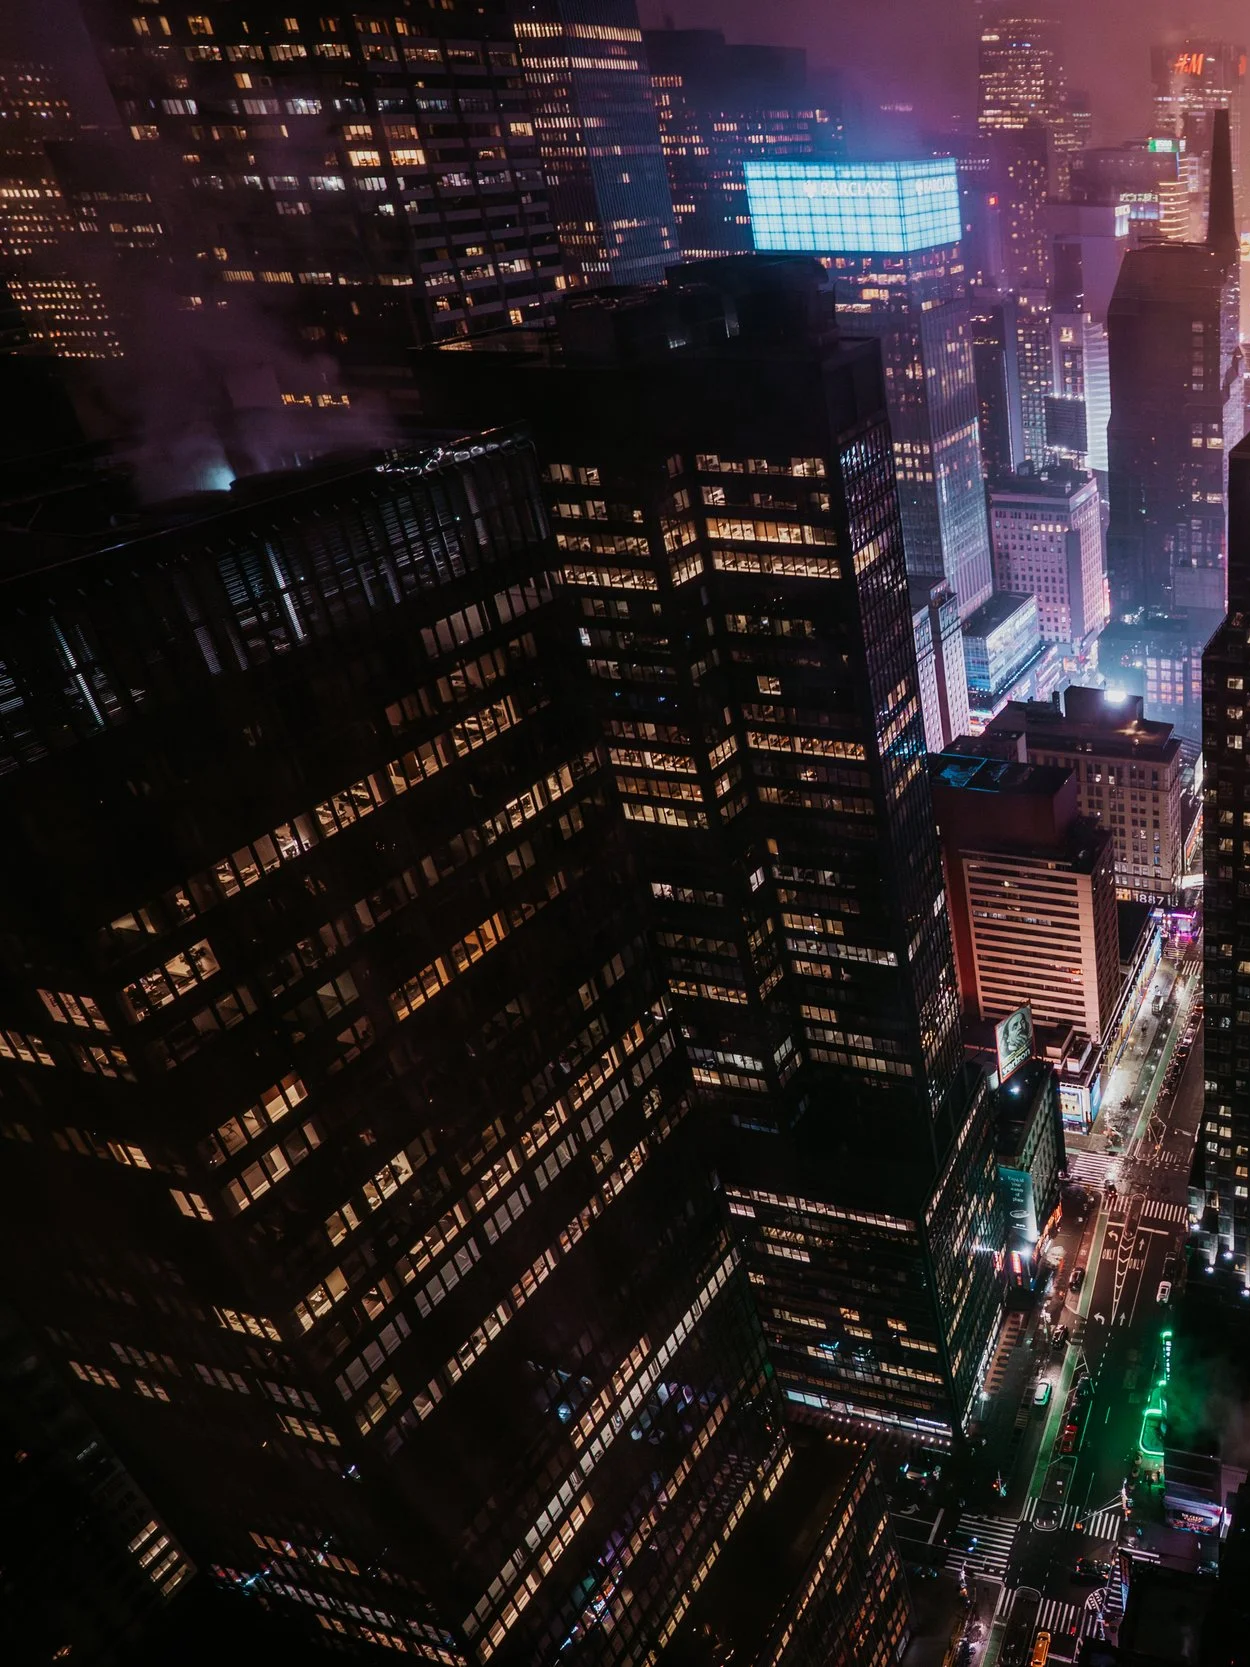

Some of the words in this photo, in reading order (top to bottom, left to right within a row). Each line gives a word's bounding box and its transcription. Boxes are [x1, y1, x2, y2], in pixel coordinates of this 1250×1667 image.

[820, 182, 889, 197] BARCLAYS
[923, 177, 955, 193] BARCLAYS
[1132, 893, 1165, 906] 1887
[1002, 1048, 1031, 1075] verizon
[1102, 1249, 1116, 1260] ONLY
[1128, 1258, 1145, 1270] ONLY
